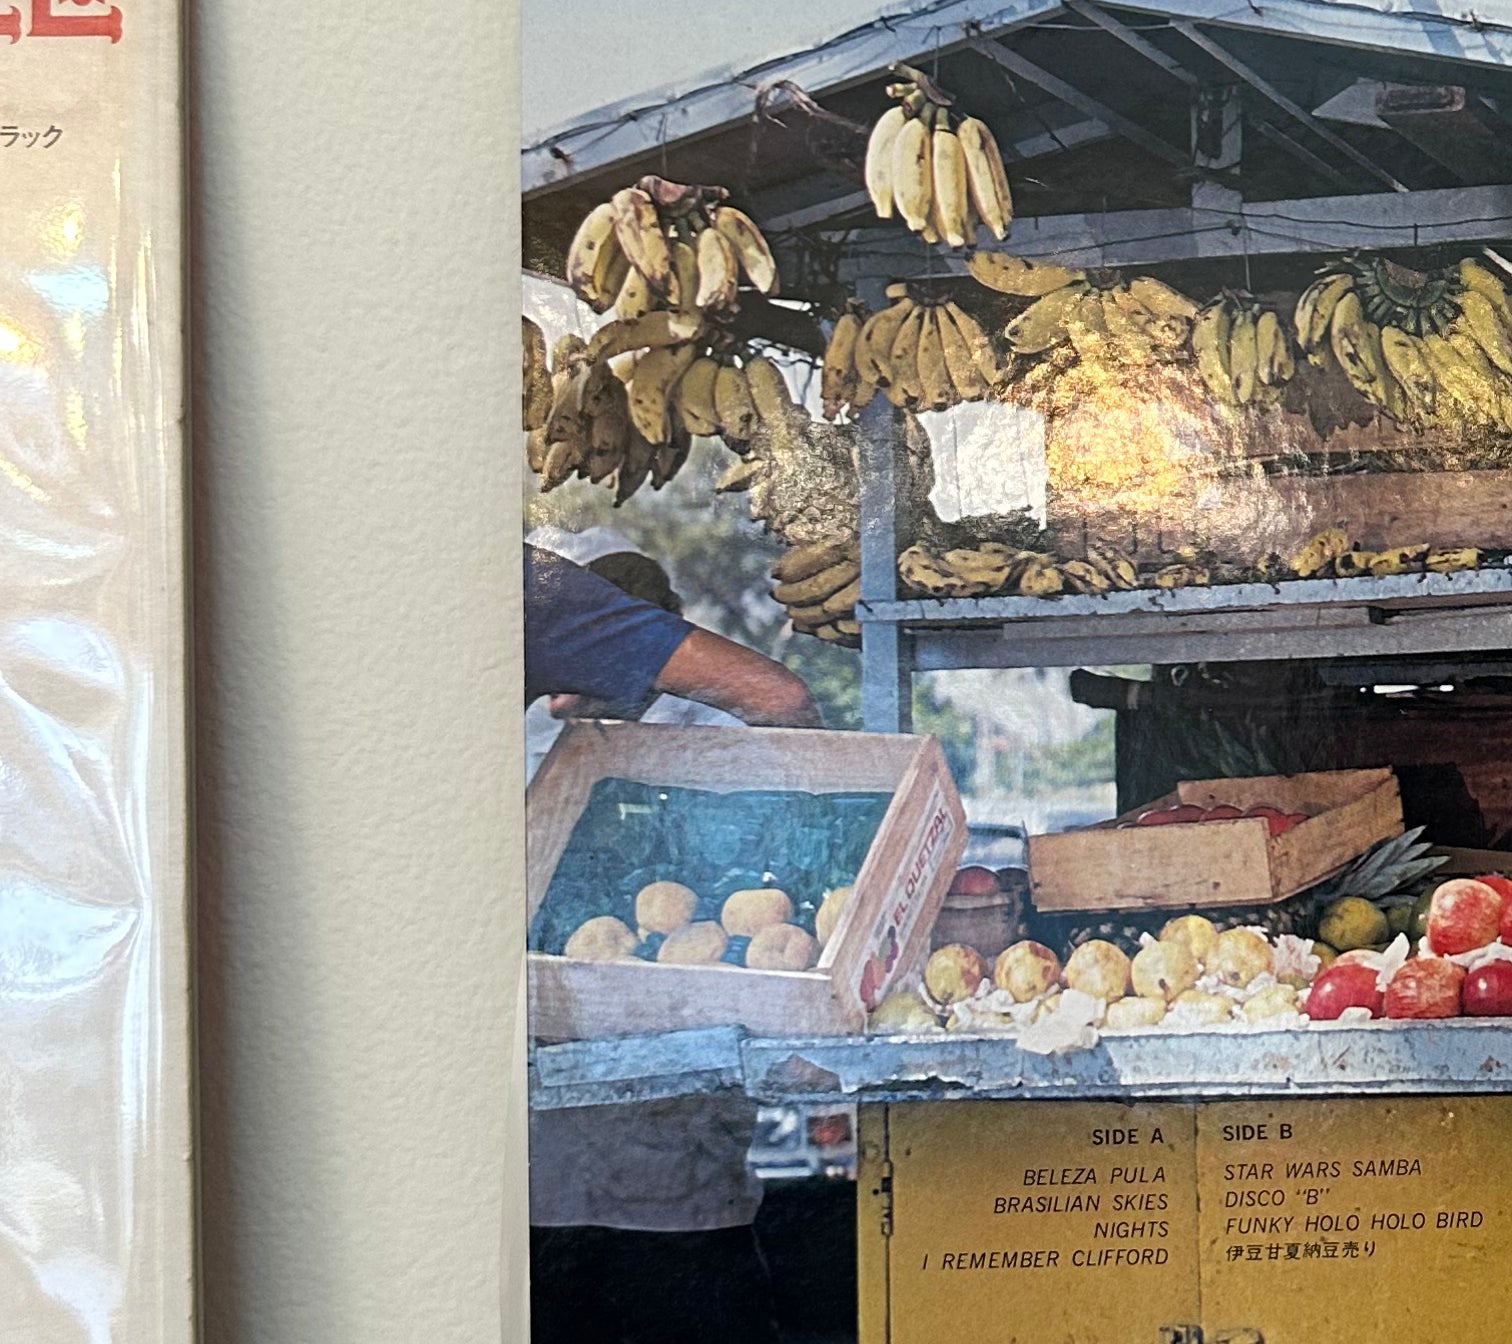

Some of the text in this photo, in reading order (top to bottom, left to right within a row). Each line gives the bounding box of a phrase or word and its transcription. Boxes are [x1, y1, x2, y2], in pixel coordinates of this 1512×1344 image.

[1092, 1128, 1165, 1146] SIDE A
[1222, 1123, 1294, 1141] SIDE B
[1023, 1166, 1166, 1186] BELEZA PULA
[1224, 1158, 1422, 1181] STAR WARS SAMBA
[993, 1193, 1169, 1214] BRASILIAN SKIES
[1225, 1189, 1285, 1208] DISCO
[1094, 1220, 1169, 1239] NIGHTS
[1225, 1210, 1484, 1235] FUNKY HOLO HOLO BIRD
[921, 1247, 1169, 1271] I REMEMBER CLIFFORD
[1226, 1240, 1376, 1262] 伊豆甘夏納豆売り
